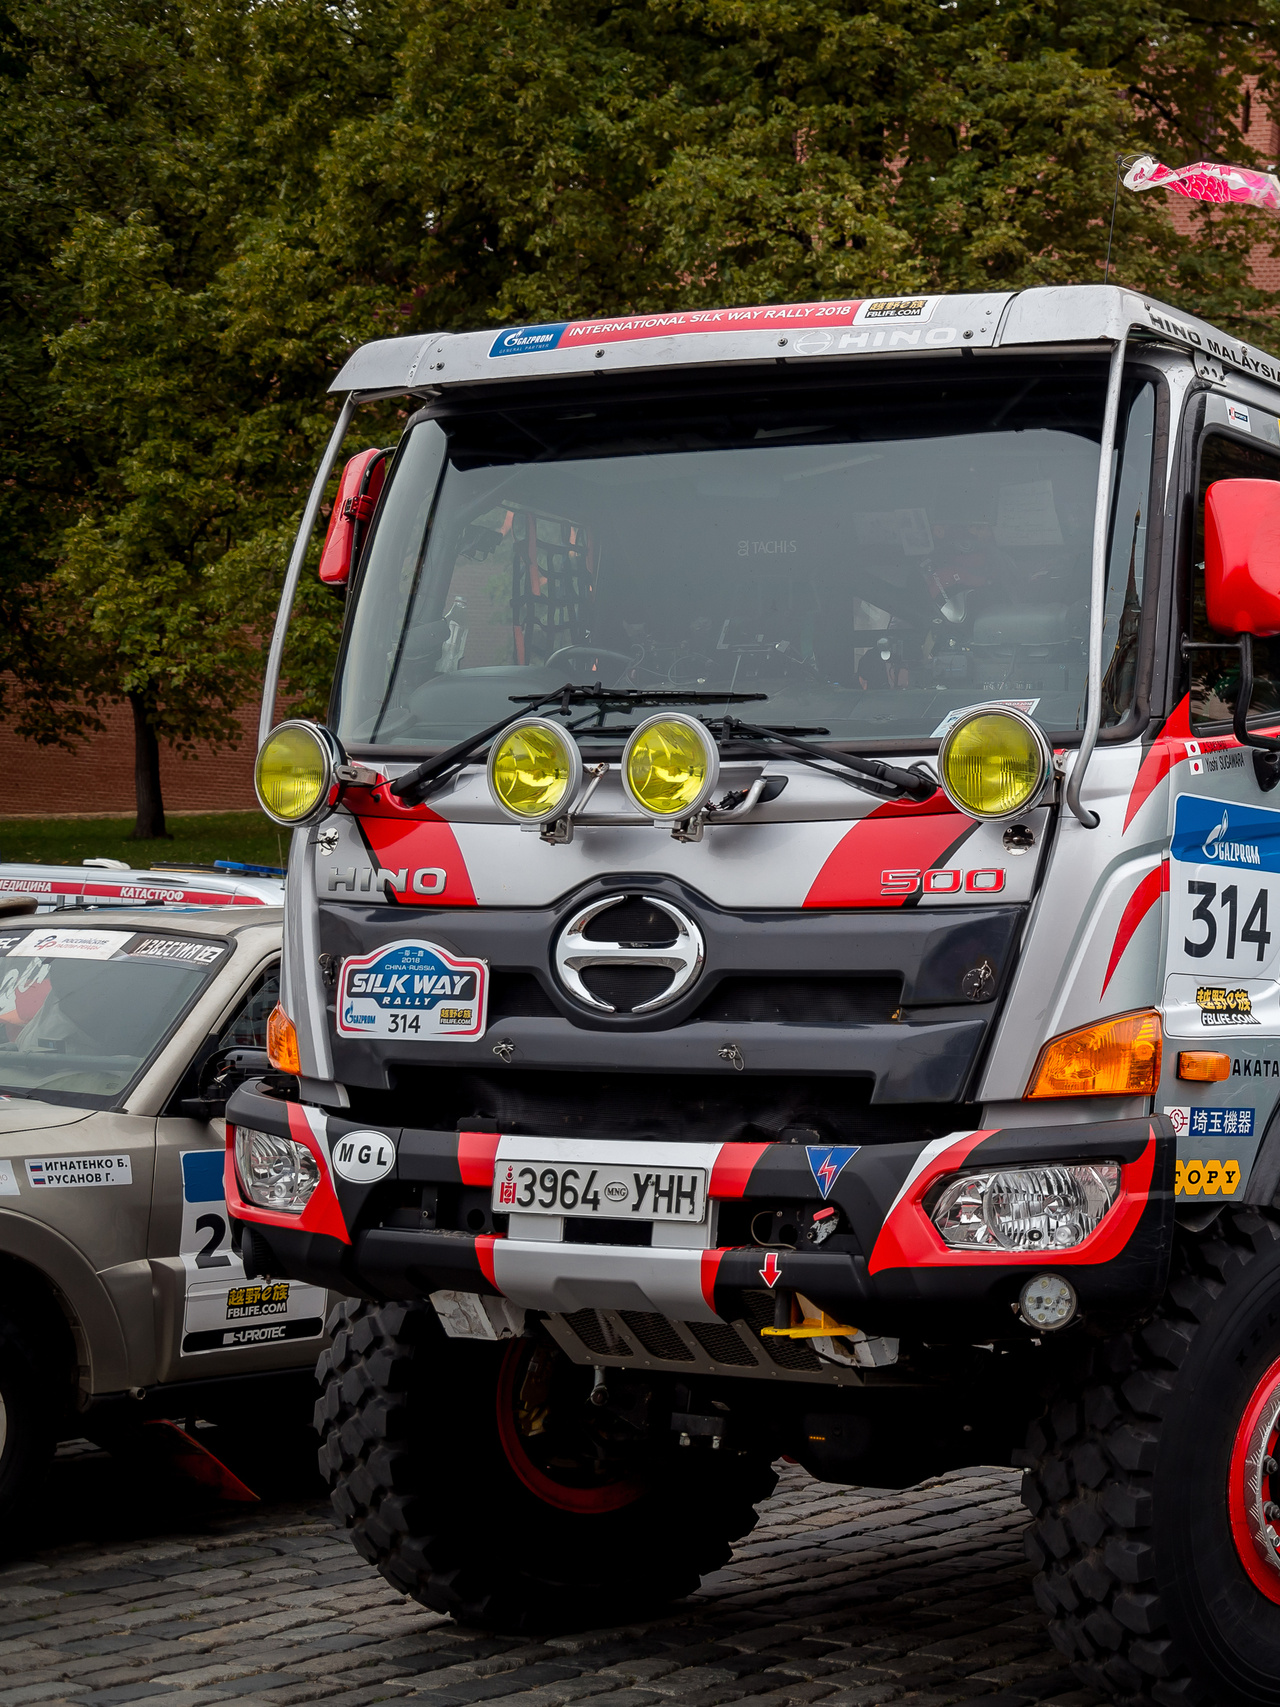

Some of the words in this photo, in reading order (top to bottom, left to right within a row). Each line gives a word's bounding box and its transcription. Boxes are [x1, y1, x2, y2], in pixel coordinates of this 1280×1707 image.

[569, 315, 686, 337] INTERNATIONAL
[689, 310, 725, 323] SILK
[727, 310, 763, 321] WAY
[764, 307, 815, 319] RALLY
[815, 306, 851, 317] 2018
[866, 309, 921, 318] FBLIFE.COM
[517, 334, 553, 346] GAZPROM
[838, 327, 957, 349] HINO
[1150, 312, 1201, 347] HINO
[1219, 842, 1261, 865] GAZPROM
[328, 867, 447, 895] HINO
[880, 868, 1007, 896] 500
[120, 886, 184, 901] КАТАСТРОФ
[1184, 879, 1272, 962] 314
[135, 938, 200, 960] ИЗВЕСТИЯ
[350, 974, 411, 994] SILK
[413, 975, 471, 995] WAY
[382, 997, 432, 1006] RALLY
[352, 1014, 376, 1024] GAZPROM
[387, 1013, 421, 1034] 314
[1201, 1012, 1259, 1026] FBLIFE.COM
[1230, 1059, 1280, 1077] AKATA
[1192, 1110, 1252, 1134] 埼玉機器
[44, 1159, 113, 1171] ИГНАТЕНКО
[117, 1158, 128, 1168] Б.
[47, 1173, 102, 1184] РУСАНОВ
[105, 1173, 115, 1182] Г.
[517, 1167, 601, 1211] 3964
[606, 1186, 628, 1198] MNG
[194, 1213, 232, 1270] 2
[227, 1302, 287, 1319] FBLIFE.COM
[231, 1326, 287, 1344] SUPROTEC
